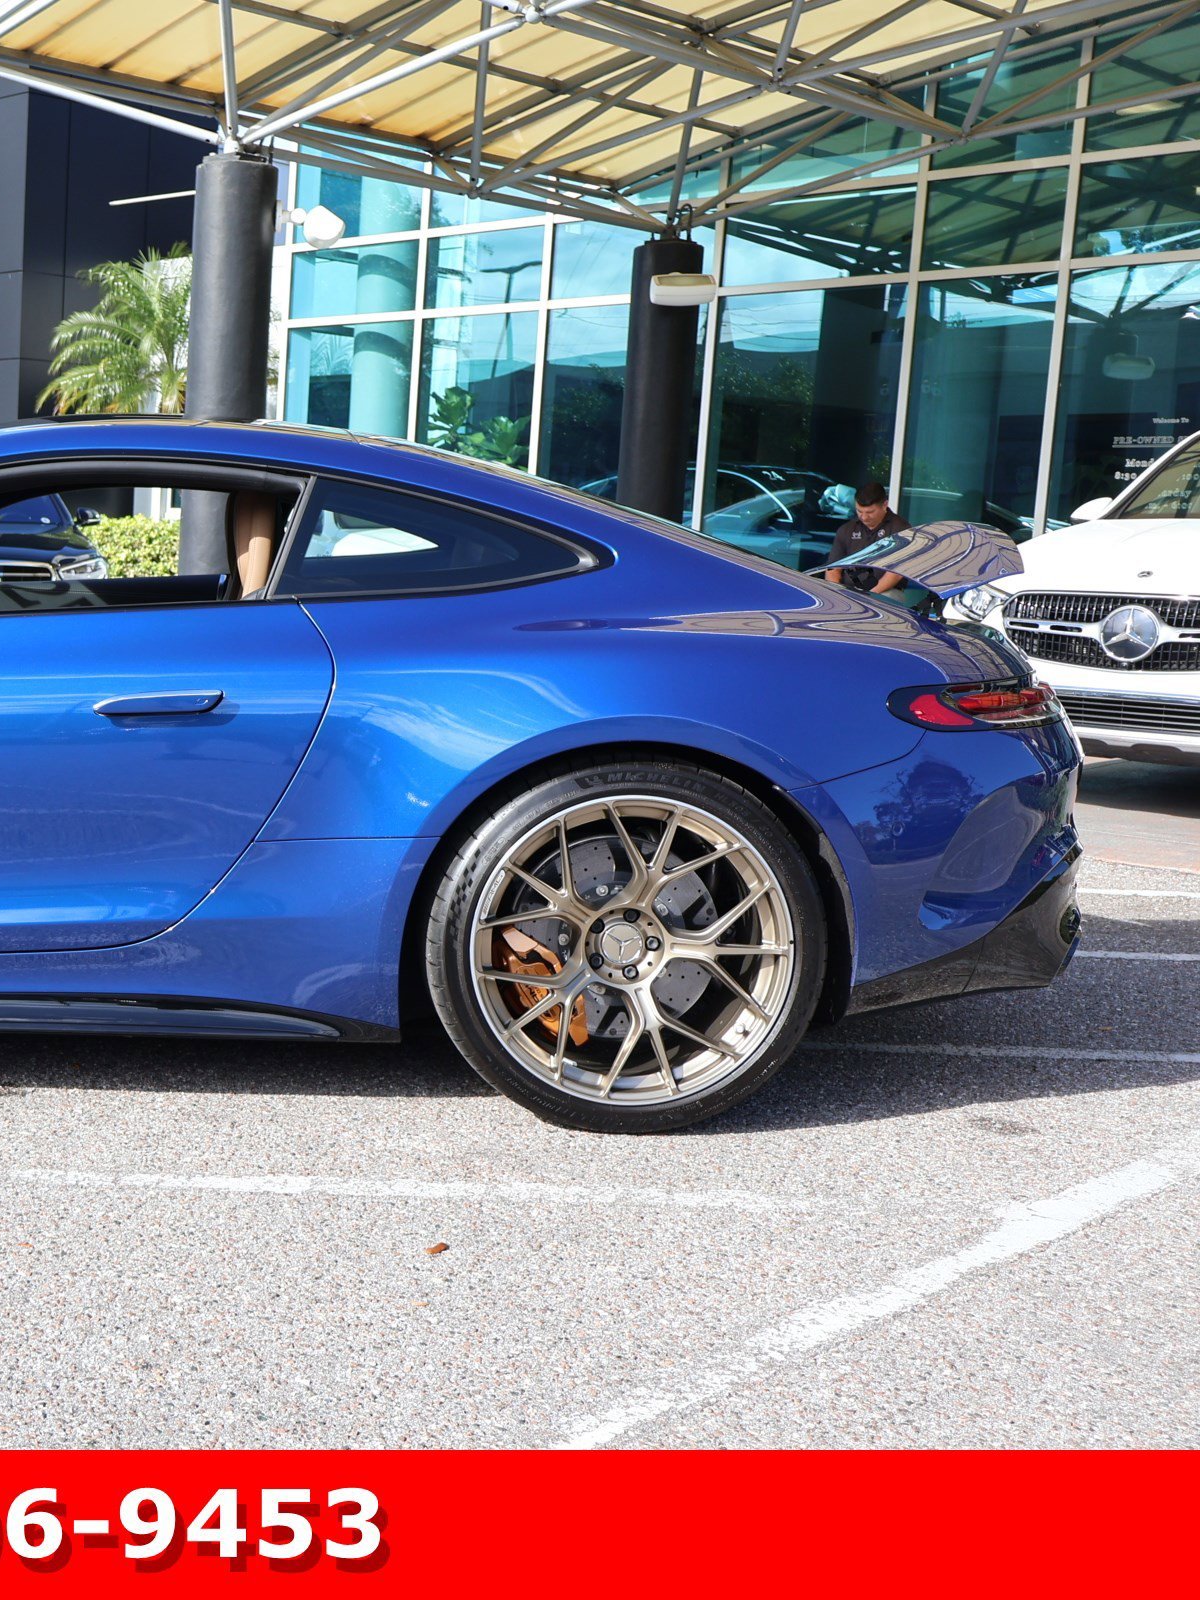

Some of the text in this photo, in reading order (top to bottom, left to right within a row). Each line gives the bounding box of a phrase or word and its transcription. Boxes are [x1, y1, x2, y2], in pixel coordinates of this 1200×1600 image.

[1113, 436, 1174, 444] PRE-OWNED
[1125, 458, 1154, 467] Mond
[607, 771, 706, 793] MICHELIN
